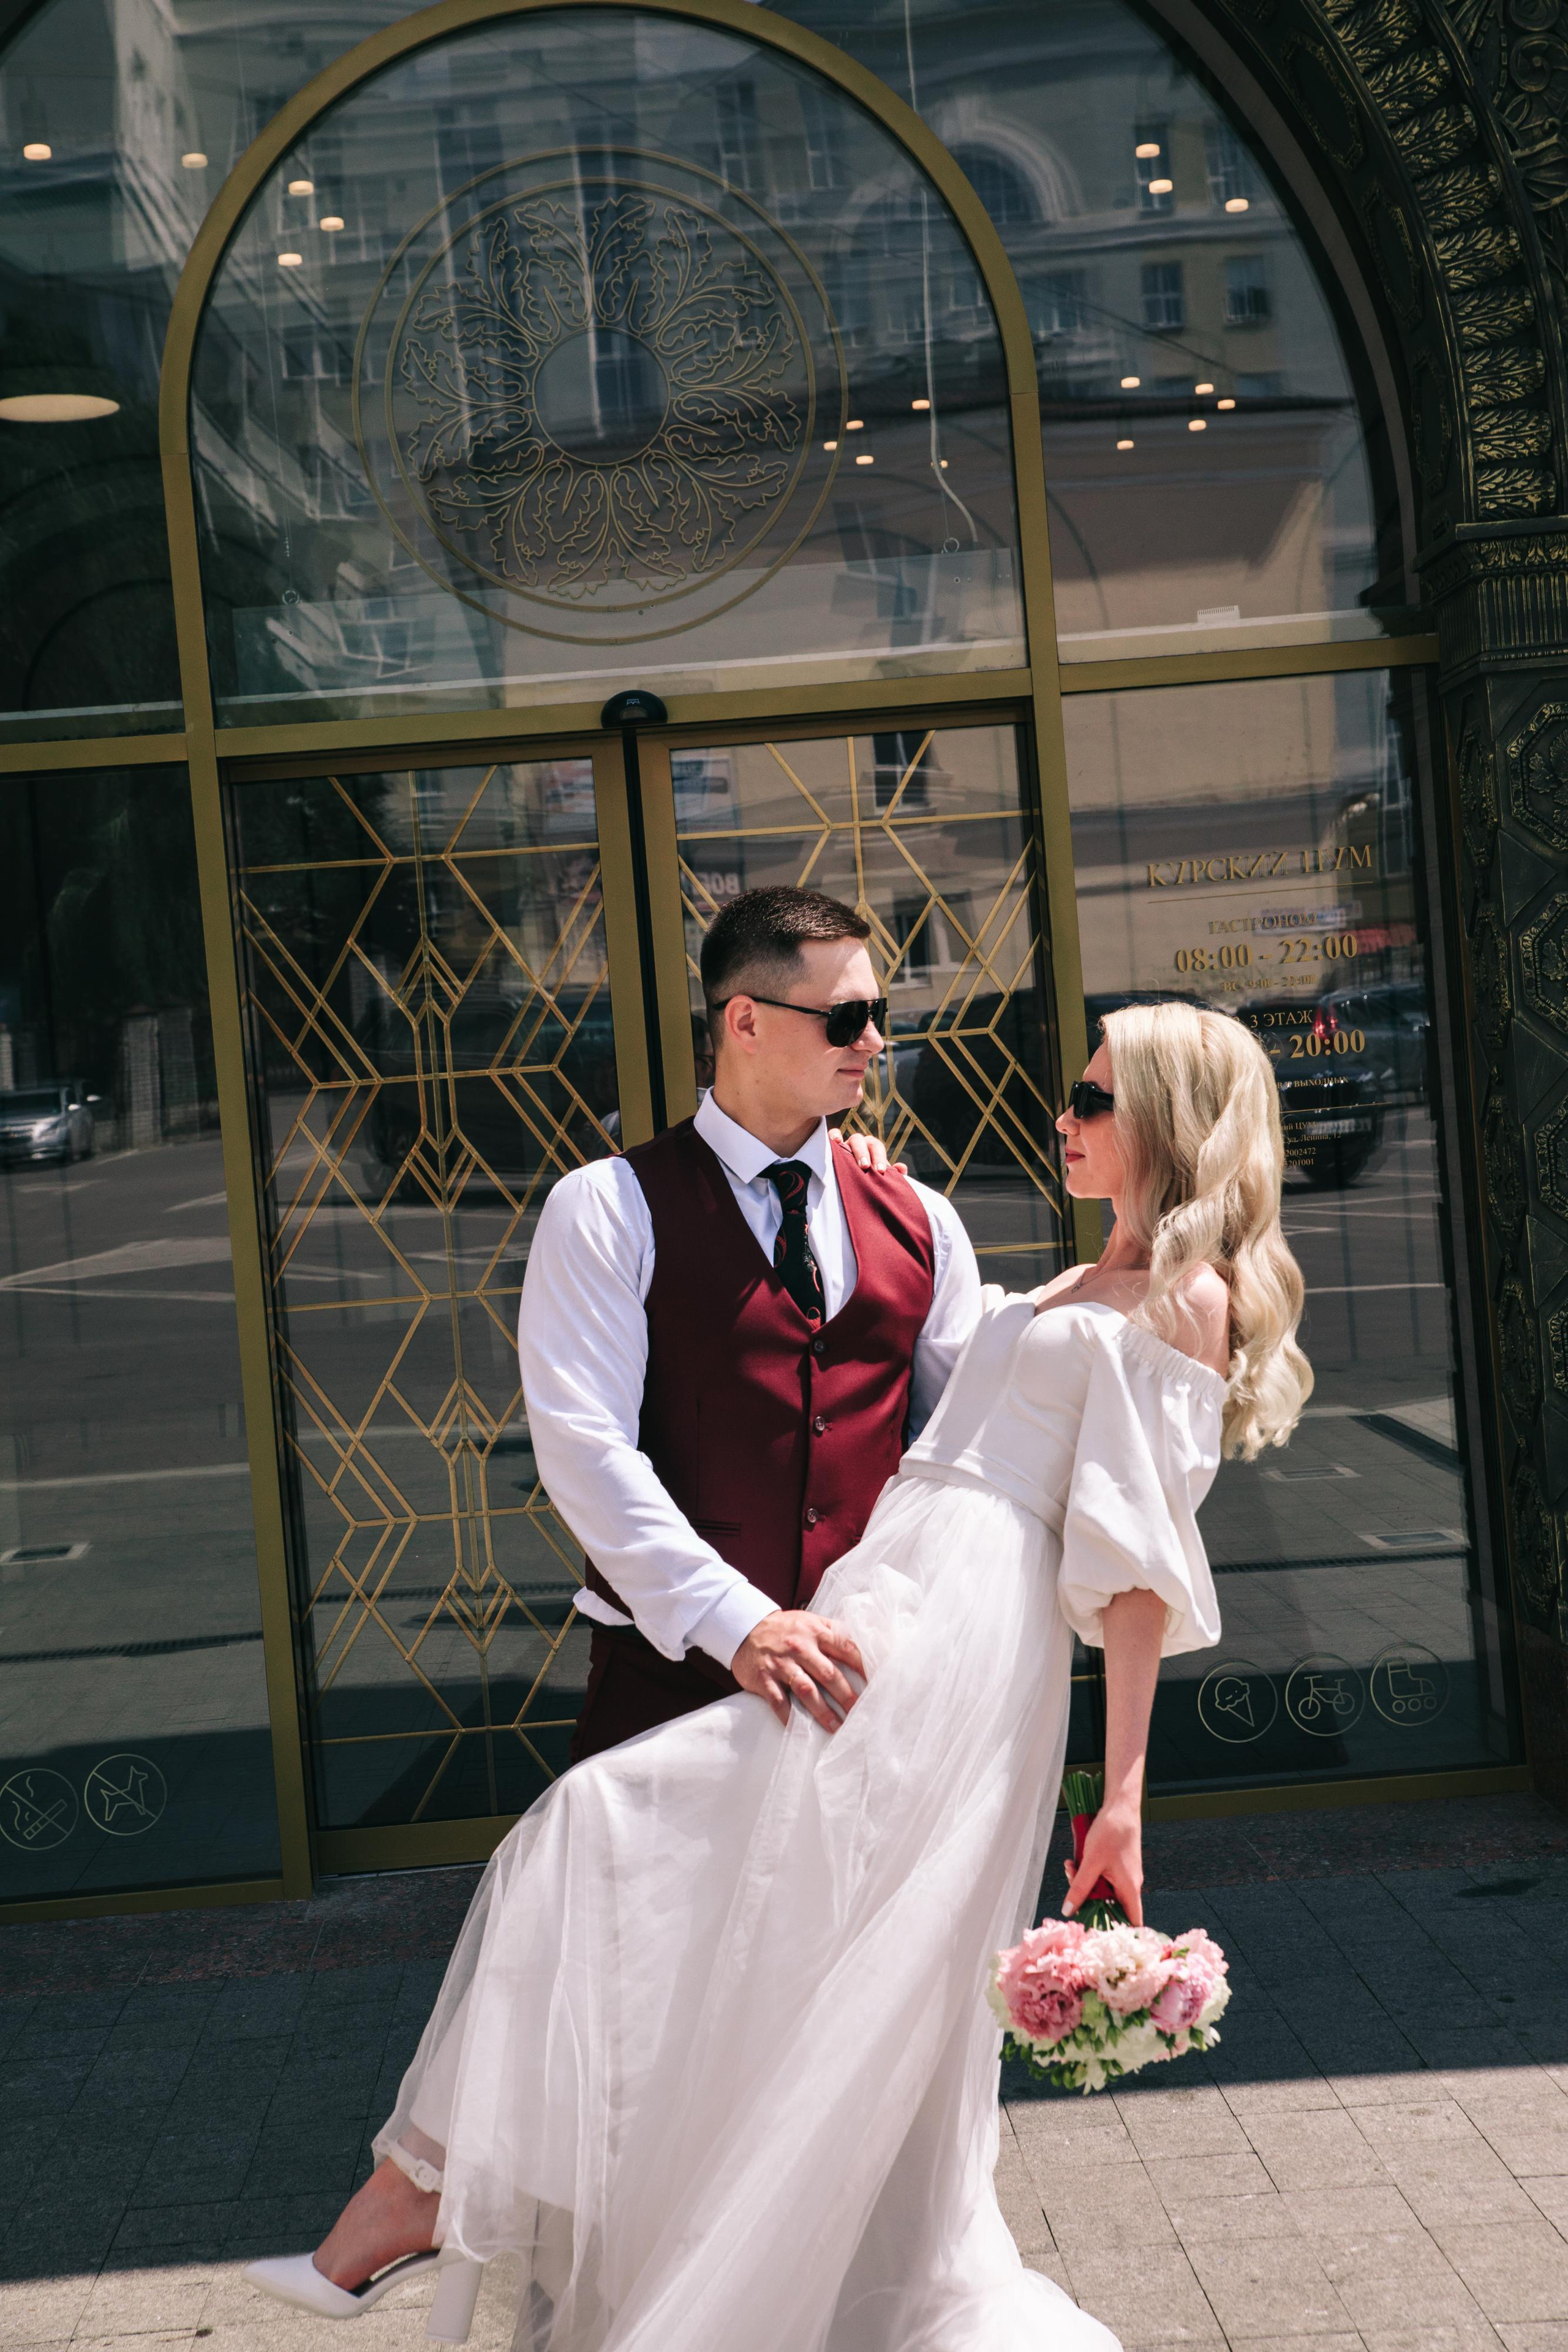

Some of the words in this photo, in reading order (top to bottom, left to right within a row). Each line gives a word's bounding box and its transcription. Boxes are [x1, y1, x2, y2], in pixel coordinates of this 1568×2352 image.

[1147, 851, 1288, 887] КУРСКИЙ
[1301, 845, 1373, 874] ЦУМ
[1208, 912, 1317, 935] ГАСТРОНОМ
[1175, 944, 1253, 973] 08:00
[1279, 933, 1358, 964] 22:00
[1250, 1014, 1258, 1028] 3
[1264, 1009, 1313, 1027] ЭТАЖ
[1289, 1029, 1365, 1058] 20:00
